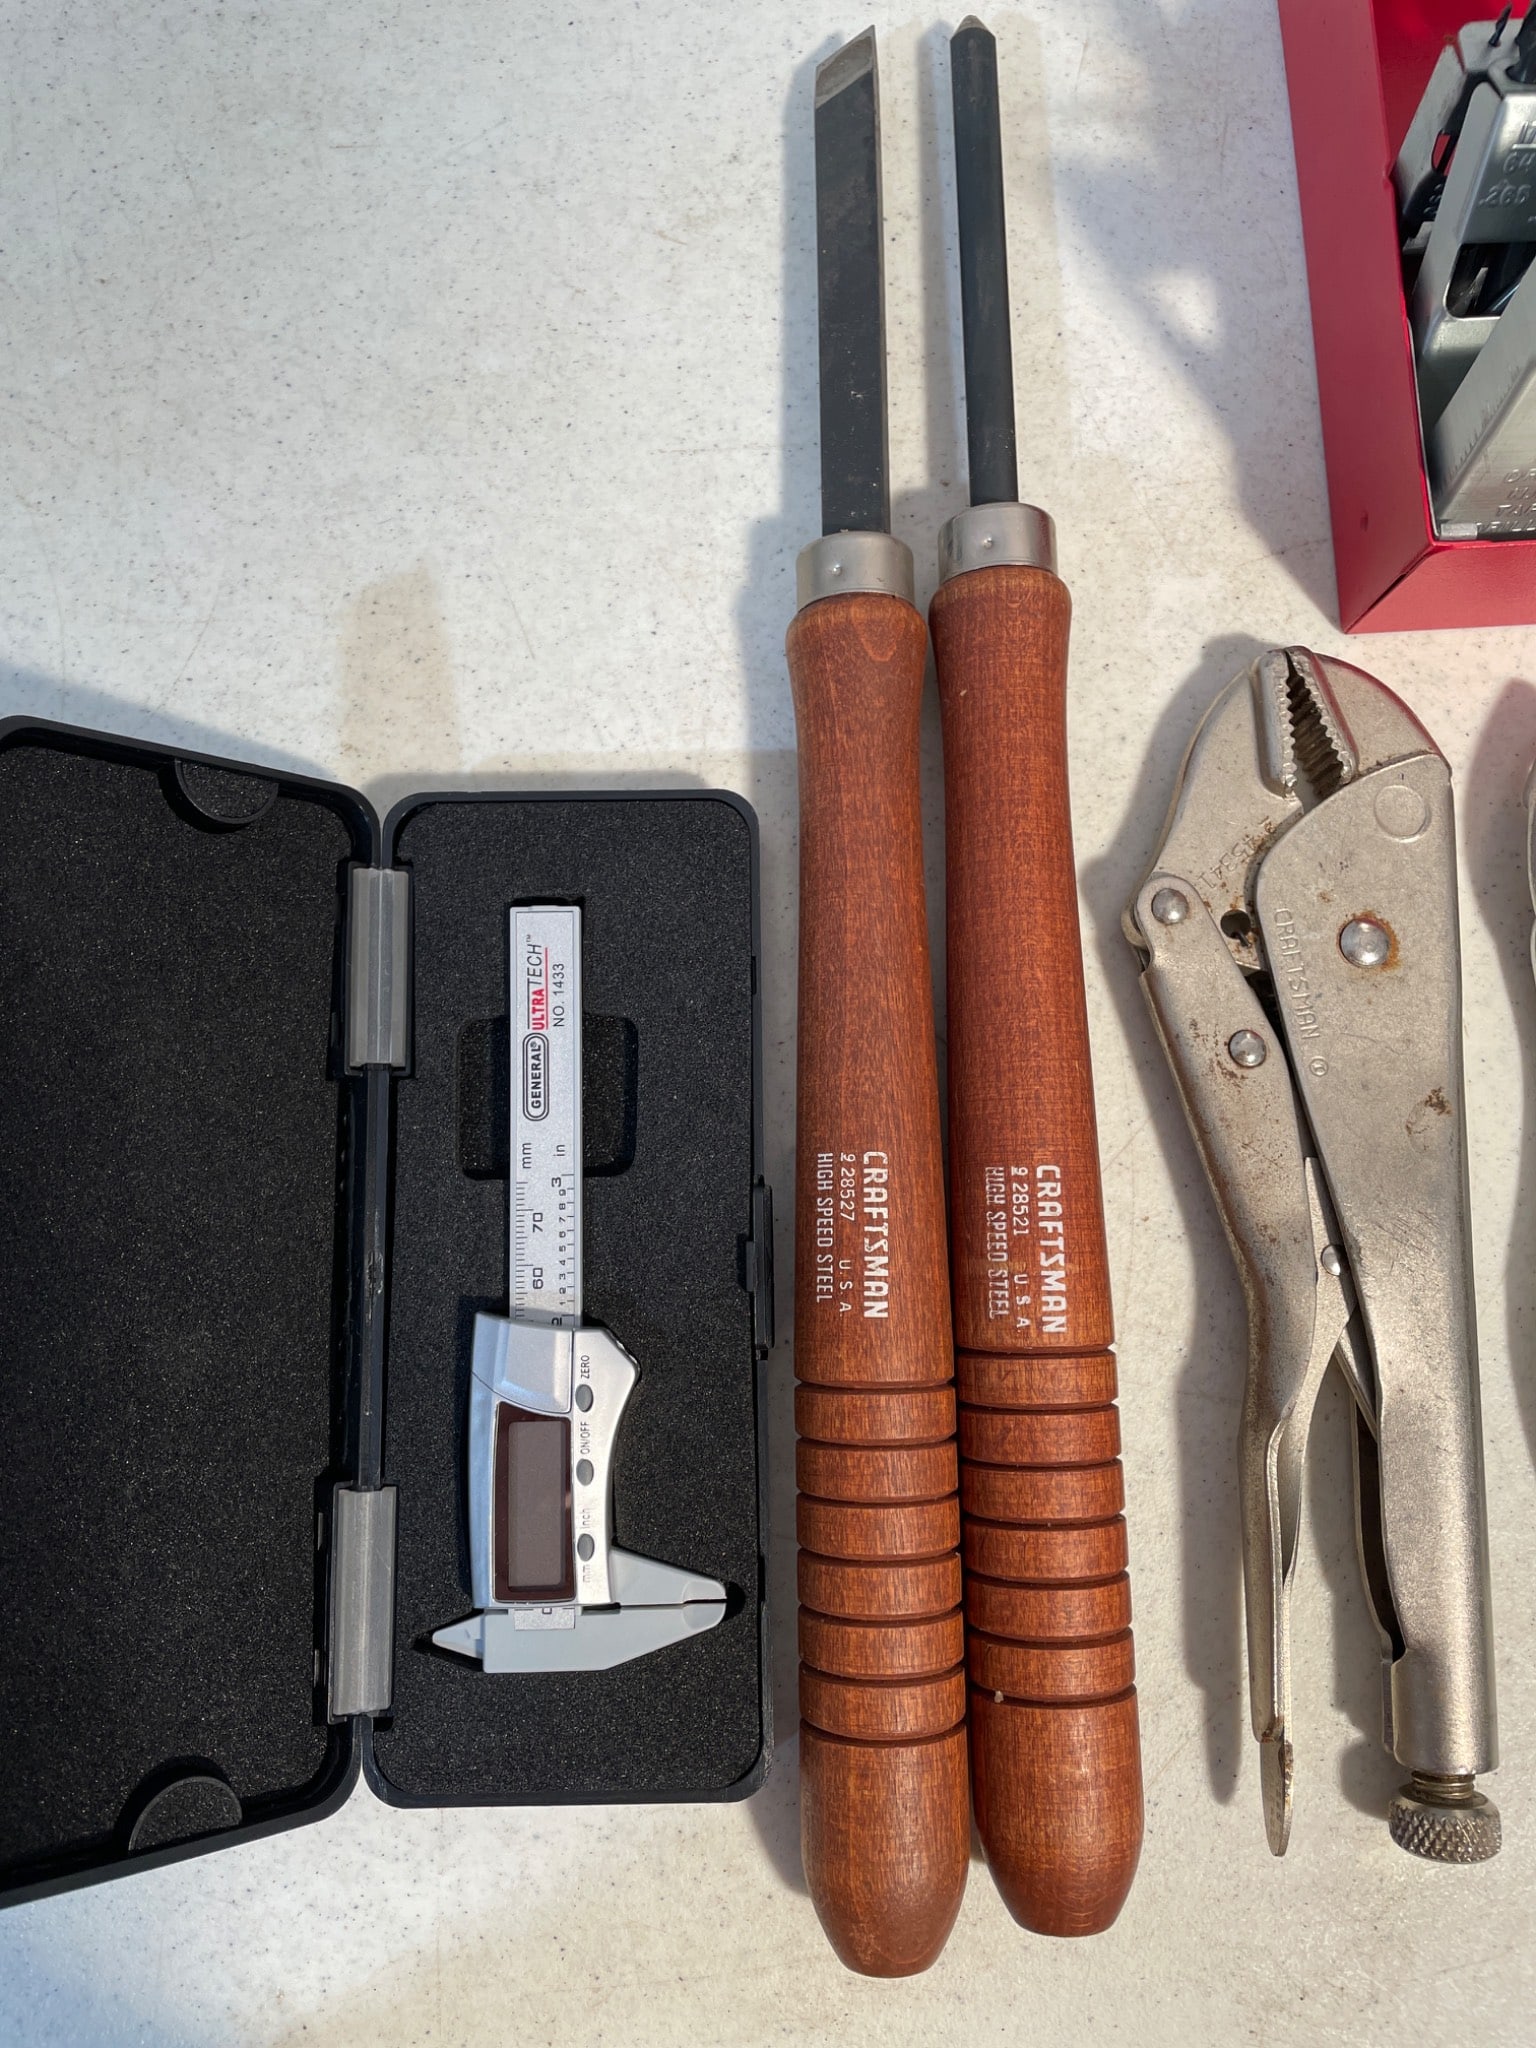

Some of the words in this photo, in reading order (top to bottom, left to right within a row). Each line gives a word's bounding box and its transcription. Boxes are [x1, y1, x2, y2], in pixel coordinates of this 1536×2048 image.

[552, 963, 565, 996] 1433
[1274, 908, 1320, 1039] CRAFTSMAN
[553, 1001, 565, 1027] NO.
[522, 1142, 532, 1169] mm
[553, 1144, 565, 1158] in
[551, 1176, 562, 1188] 3
[816, 1153, 834, 1191] HIGH
[985, 1167, 1006, 1206] HIGH
[559, 1188, 566, 1196] 9
[559, 1202, 566, 1210] 8
[840, 1167, 856, 1221] 28527
[532, 1212, 544, 1233] 70
[816, 1197, 834, 1248] SPEED
[1012, 1183, 1030, 1236] 28521
[559, 1230, 566, 1238] 6
[863, 1151, 889, 1318] CRAFTSMAN
[986, 1211, 1009, 1262] SPEED
[1036, 1165, 1068, 1333] CRAFTSMAN
[532, 1267, 544, 1289] 60
[559, 1287, 566, 1295] 2
[816, 1254, 834, 1303] STEEL
[988, 1269, 1010, 1319] STEEL
[580, 1355, 590, 1379] ZERO
[580, 1421, 591, 1455] ON/OFF
